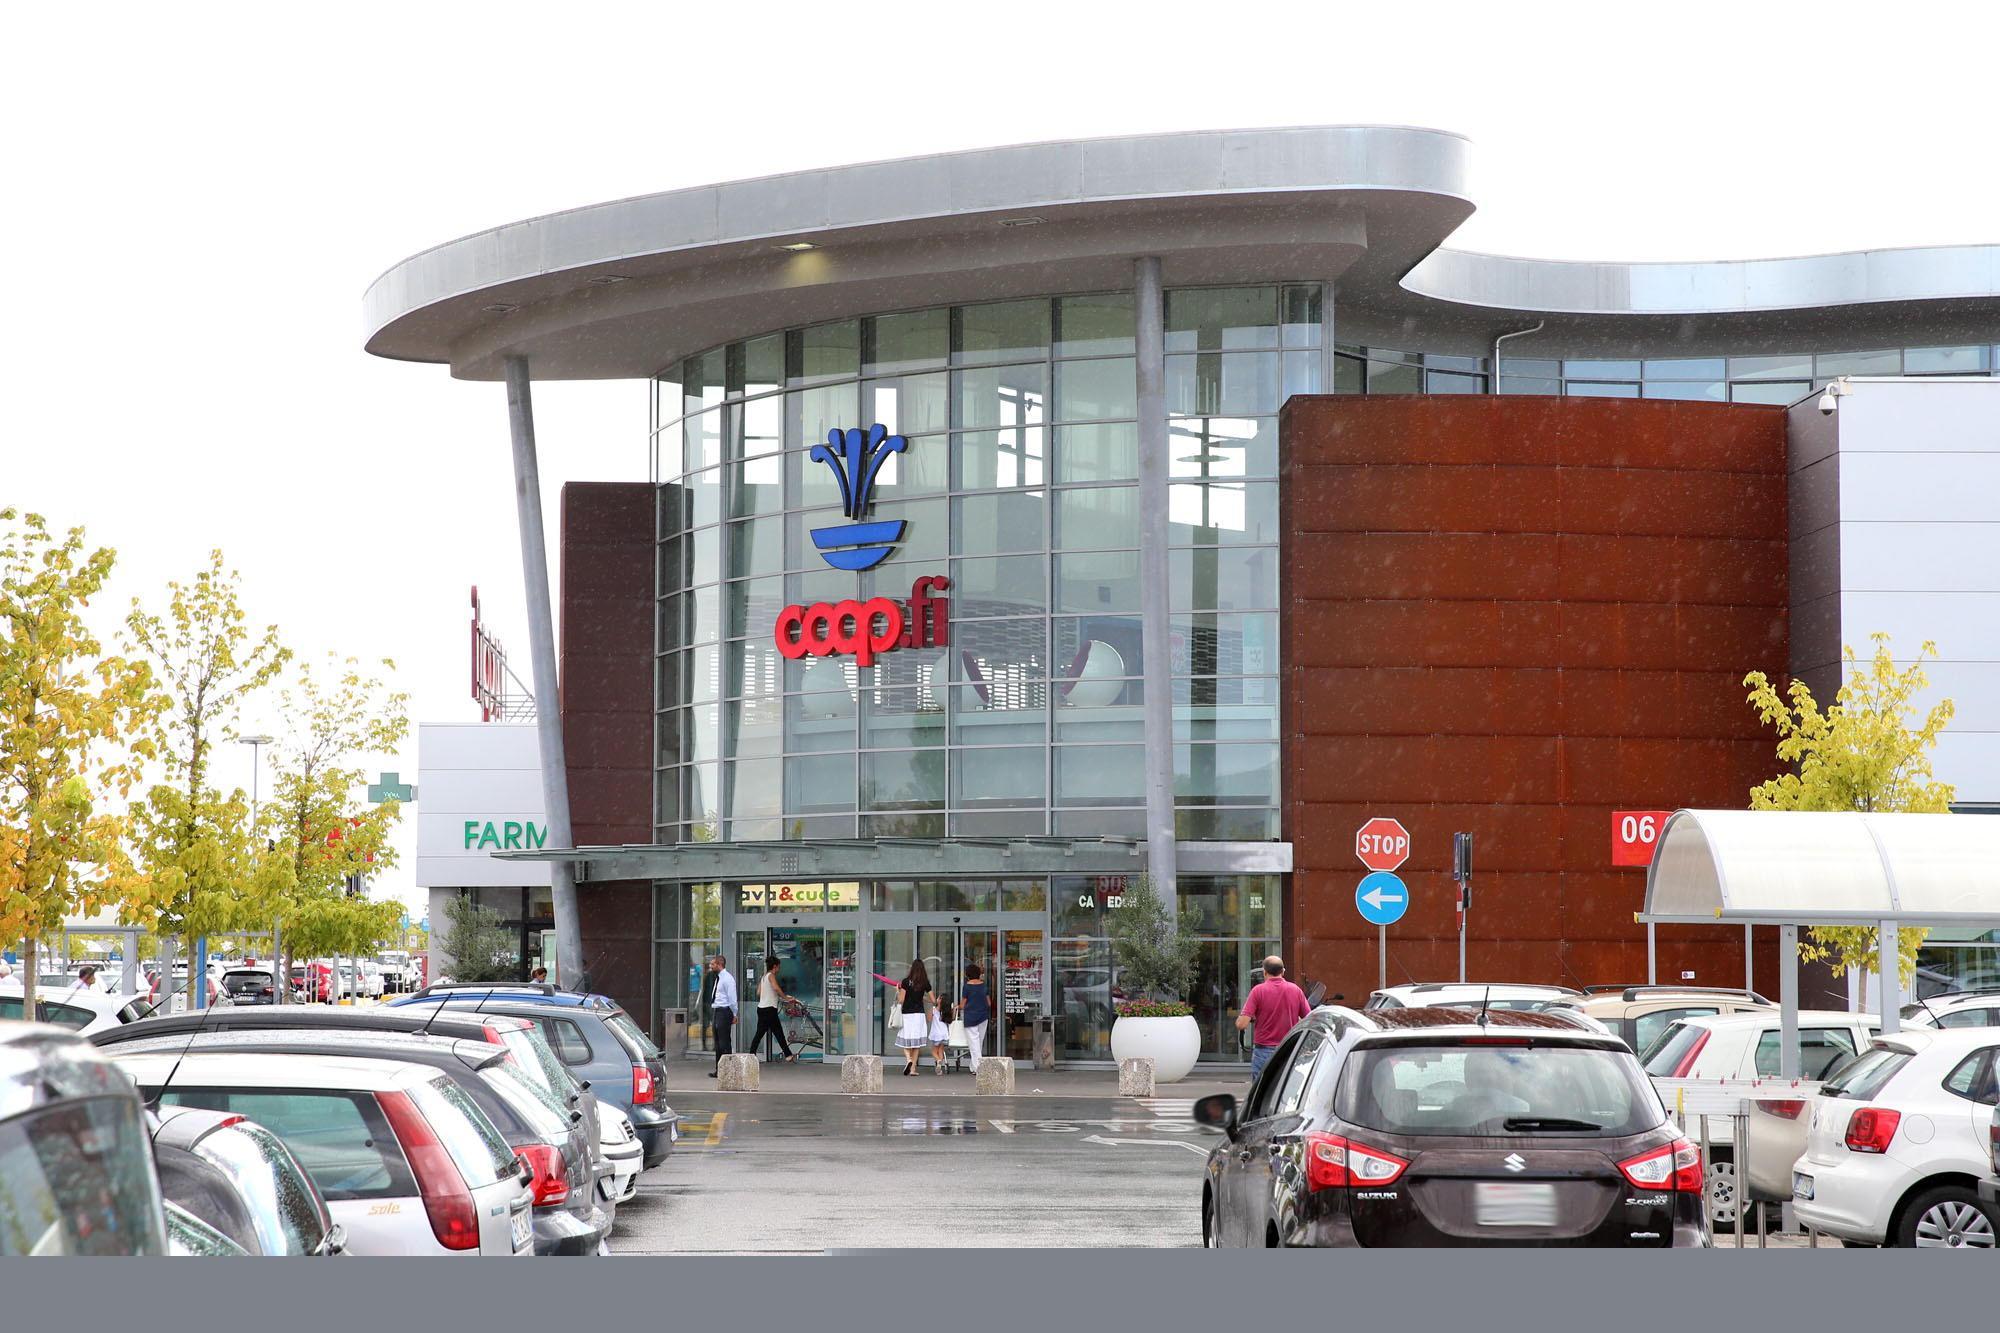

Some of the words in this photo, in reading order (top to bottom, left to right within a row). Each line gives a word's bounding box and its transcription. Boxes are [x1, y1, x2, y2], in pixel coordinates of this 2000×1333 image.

[775, 575, 950, 667] coop.fi
[464, 821, 548, 849] FARM
[1621, 815, 1656, 844] 06
[1360, 833, 1407, 856] STOP
[1357, 1192, 1398, 1200] SUZUKI
[367, 1202, 401, 1216] sole
